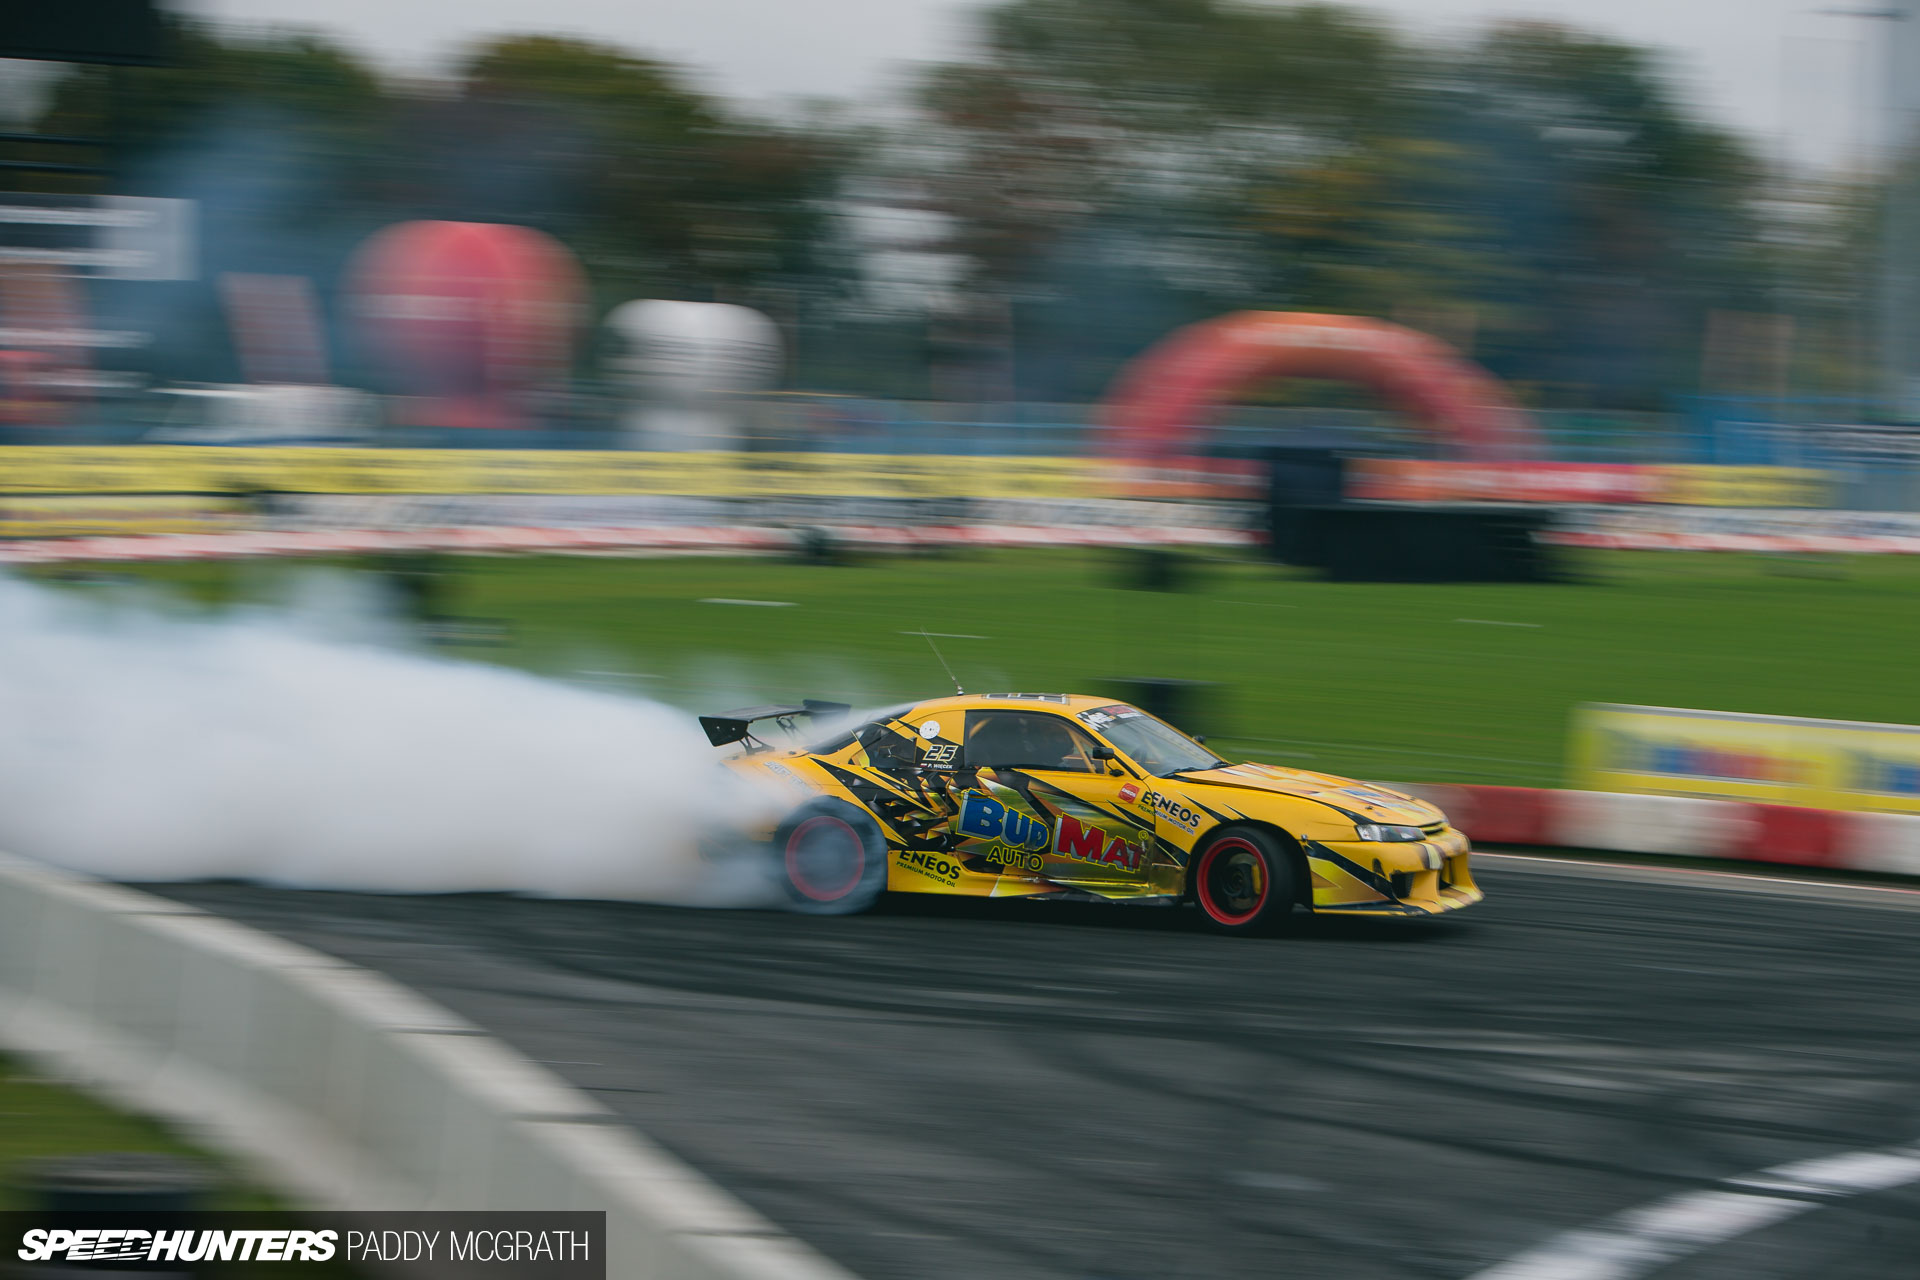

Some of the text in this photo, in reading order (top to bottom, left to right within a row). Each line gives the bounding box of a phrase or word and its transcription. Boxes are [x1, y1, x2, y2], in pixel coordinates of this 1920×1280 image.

[922, 744, 959, 762] 25
[899, 849, 962, 880] ENEOS
[986, 845, 1044, 872] AUTO
[896, 860, 956, 888] PREMIUM MOTOR OIL
